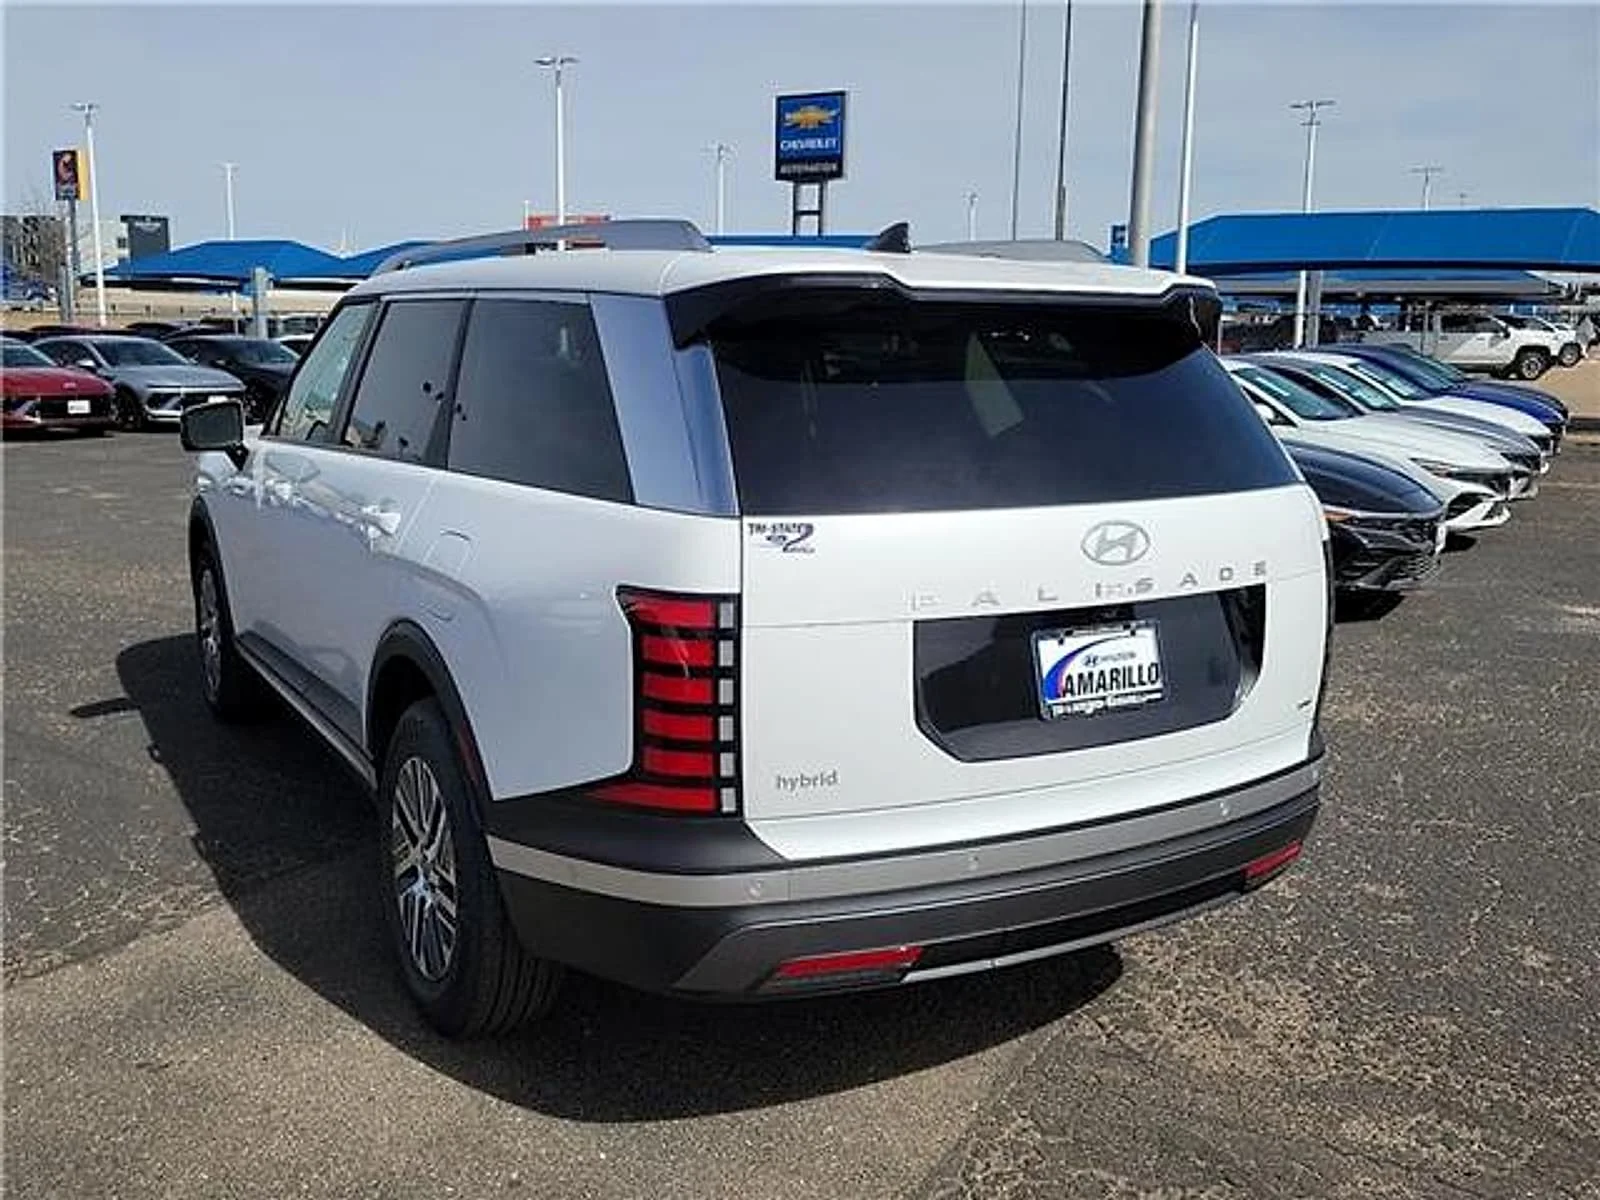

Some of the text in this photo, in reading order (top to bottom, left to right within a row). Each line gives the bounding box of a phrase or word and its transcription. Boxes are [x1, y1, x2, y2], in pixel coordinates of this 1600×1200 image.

[911, 560, 1267, 611] PALISADE
[1062, 662, 1160, 699] AMARILLO
[776, 767, 838, 792] hybrid
